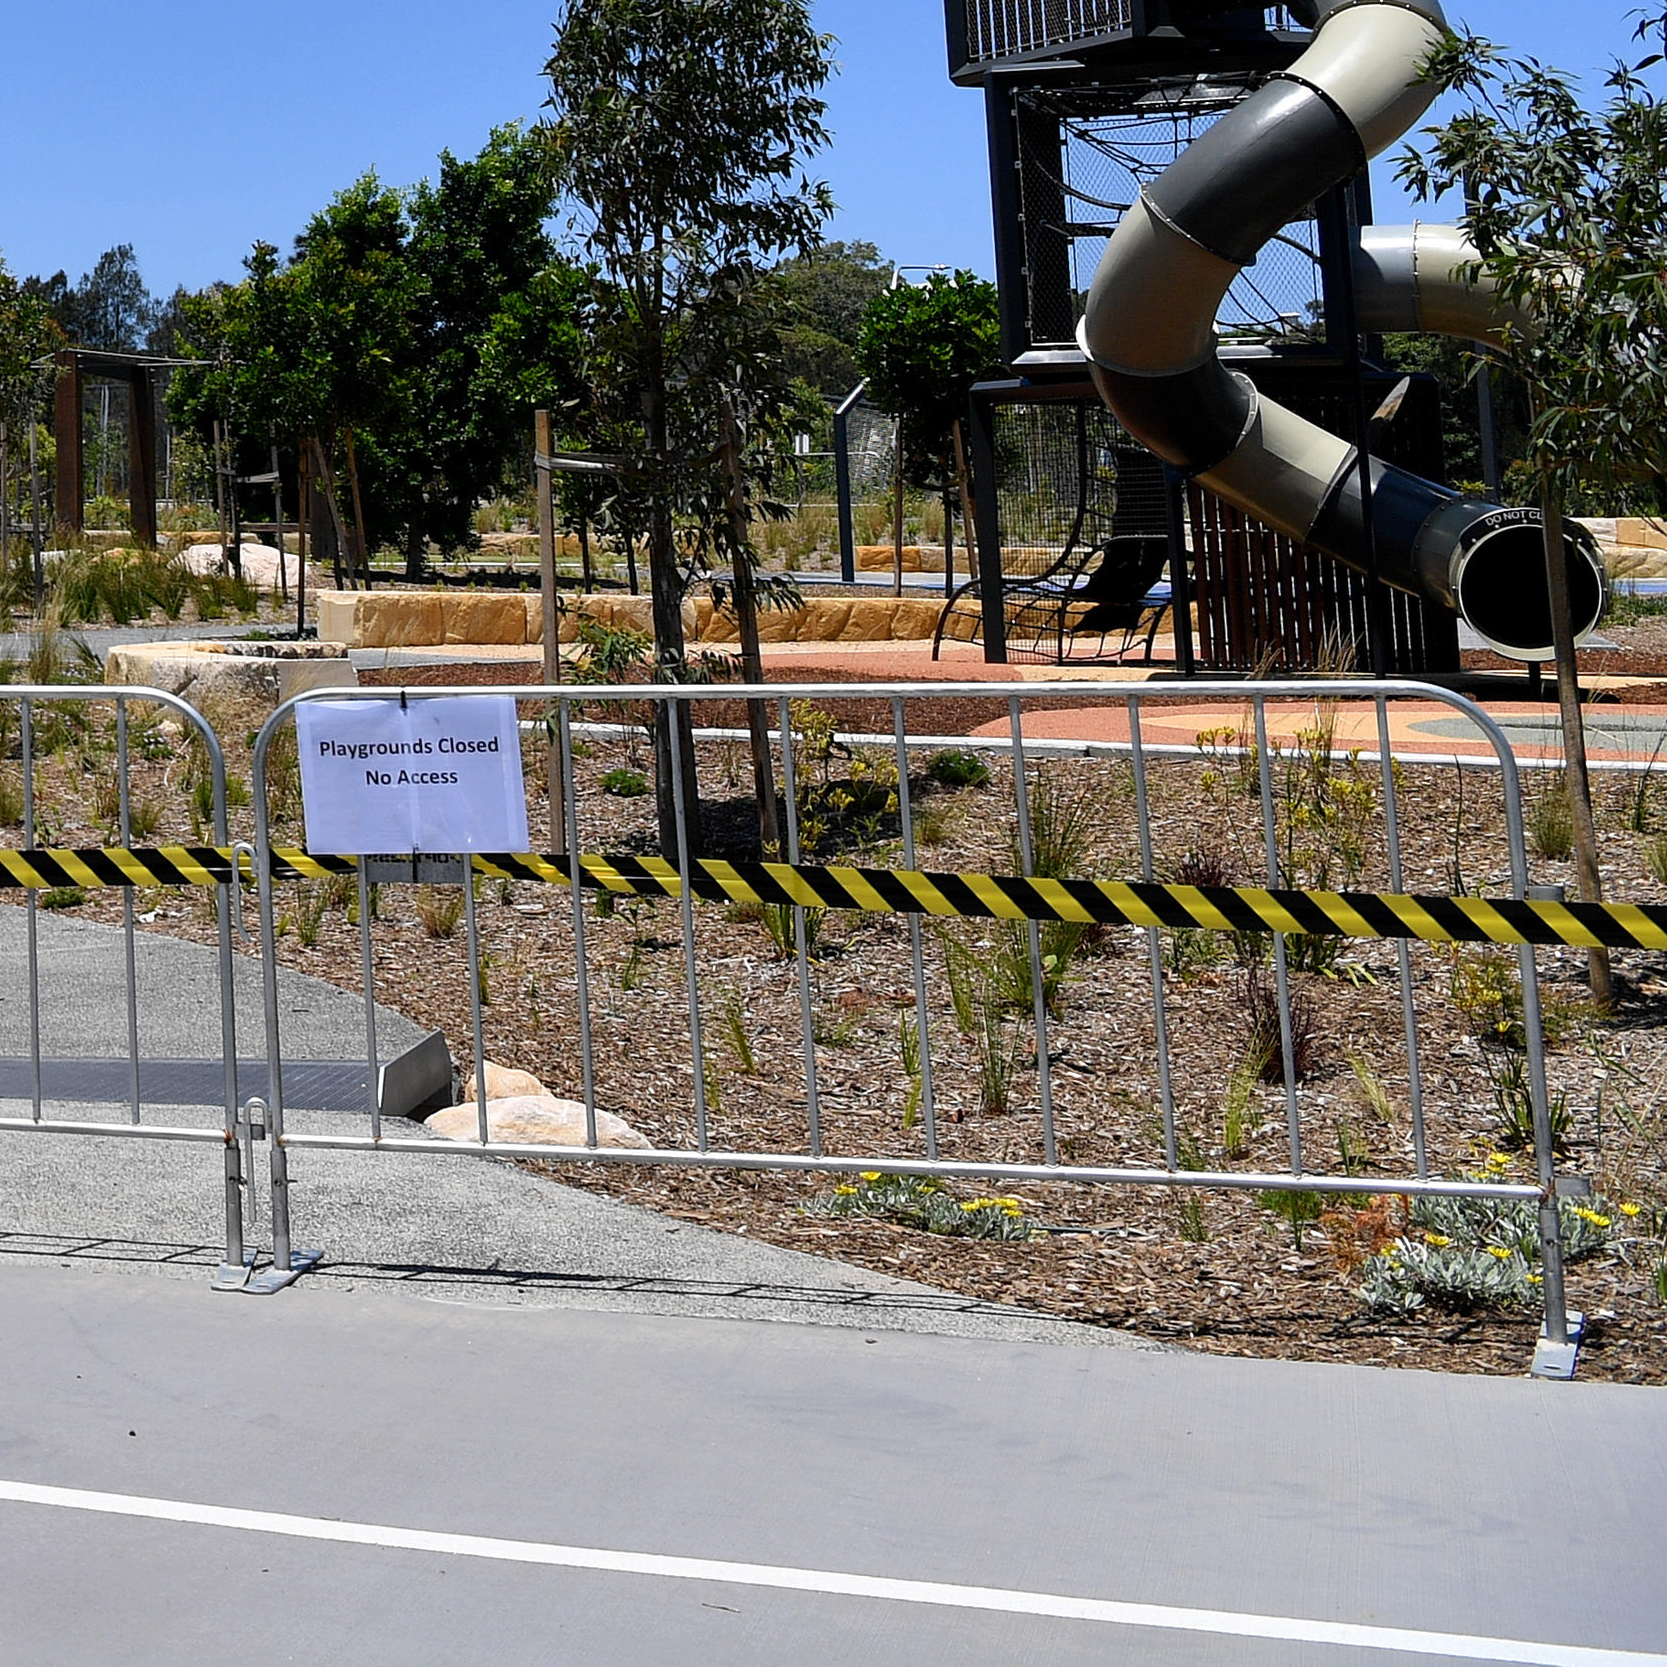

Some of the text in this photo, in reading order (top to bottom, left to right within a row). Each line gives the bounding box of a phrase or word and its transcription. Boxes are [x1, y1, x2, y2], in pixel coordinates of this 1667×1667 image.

[1485, 514, 1502, 526] DO
[1503, 511, 1527, 520] NOT
[319, 736, 499, 759] Playgrounds Closed
[365, 770, 458, 785] No Access
